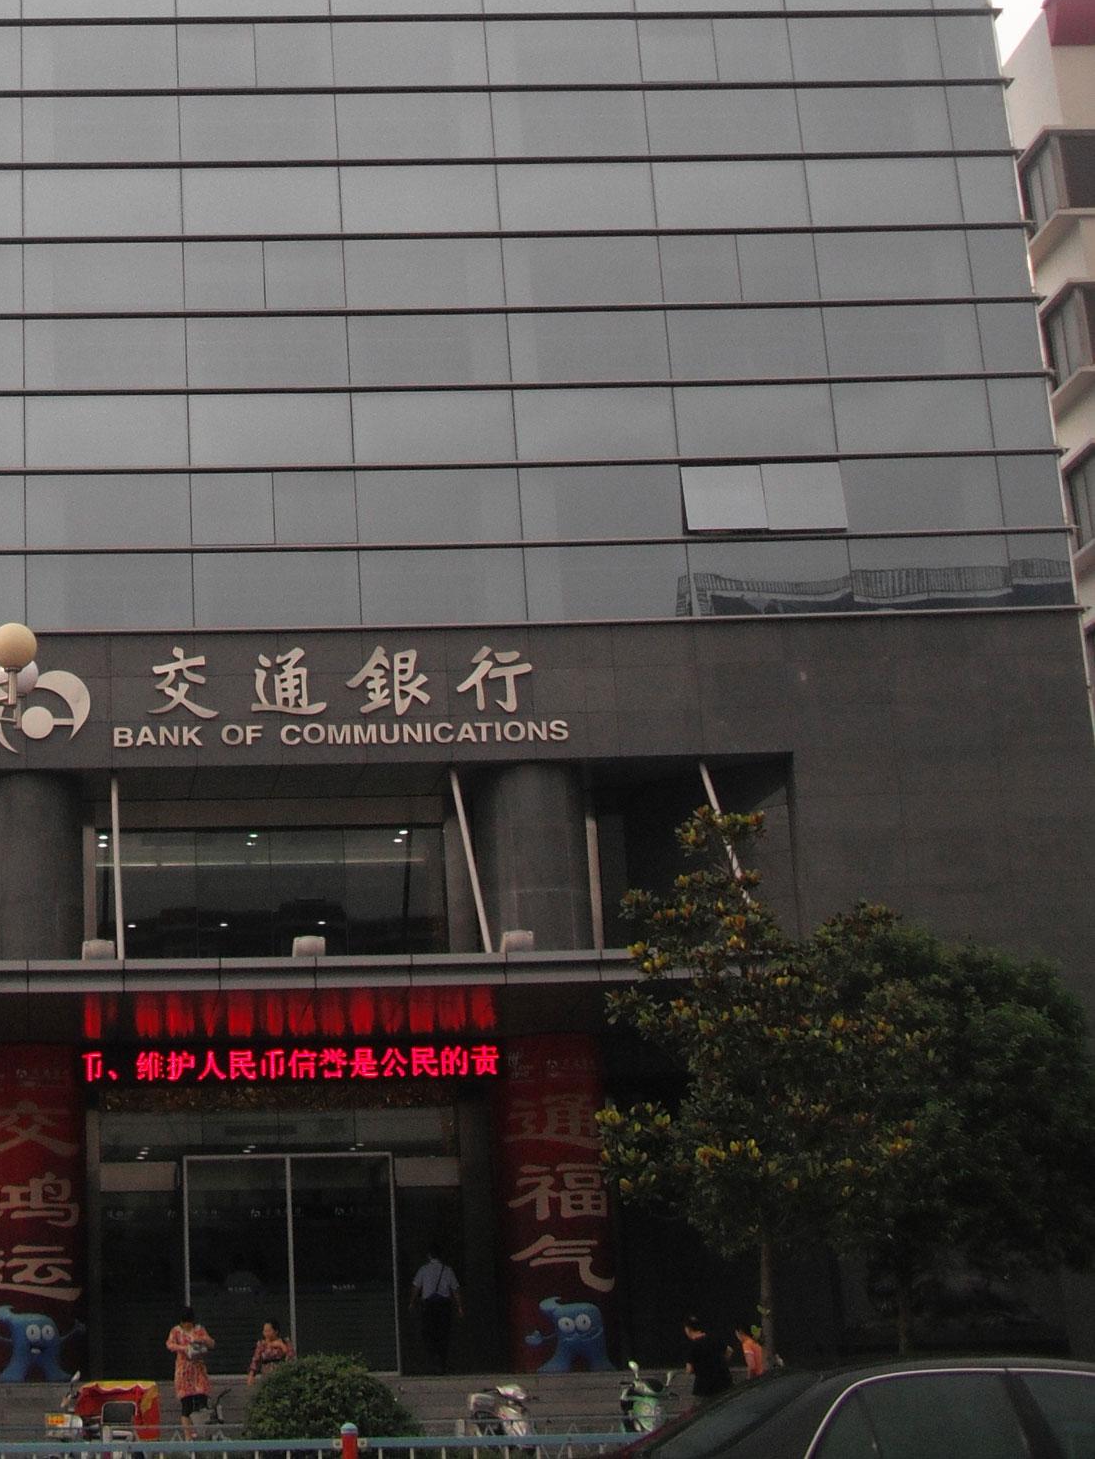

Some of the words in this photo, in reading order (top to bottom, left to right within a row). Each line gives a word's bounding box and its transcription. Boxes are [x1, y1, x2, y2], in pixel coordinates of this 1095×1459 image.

[147, 645, 533, 719] 交通銀行
[113, 725, 204, 748] BANK
[220, 724, 264, 746] OF
[280, 719, 570, 746] COMMUNICATIONS
[507, 1092, 616, 1293] 通福气
